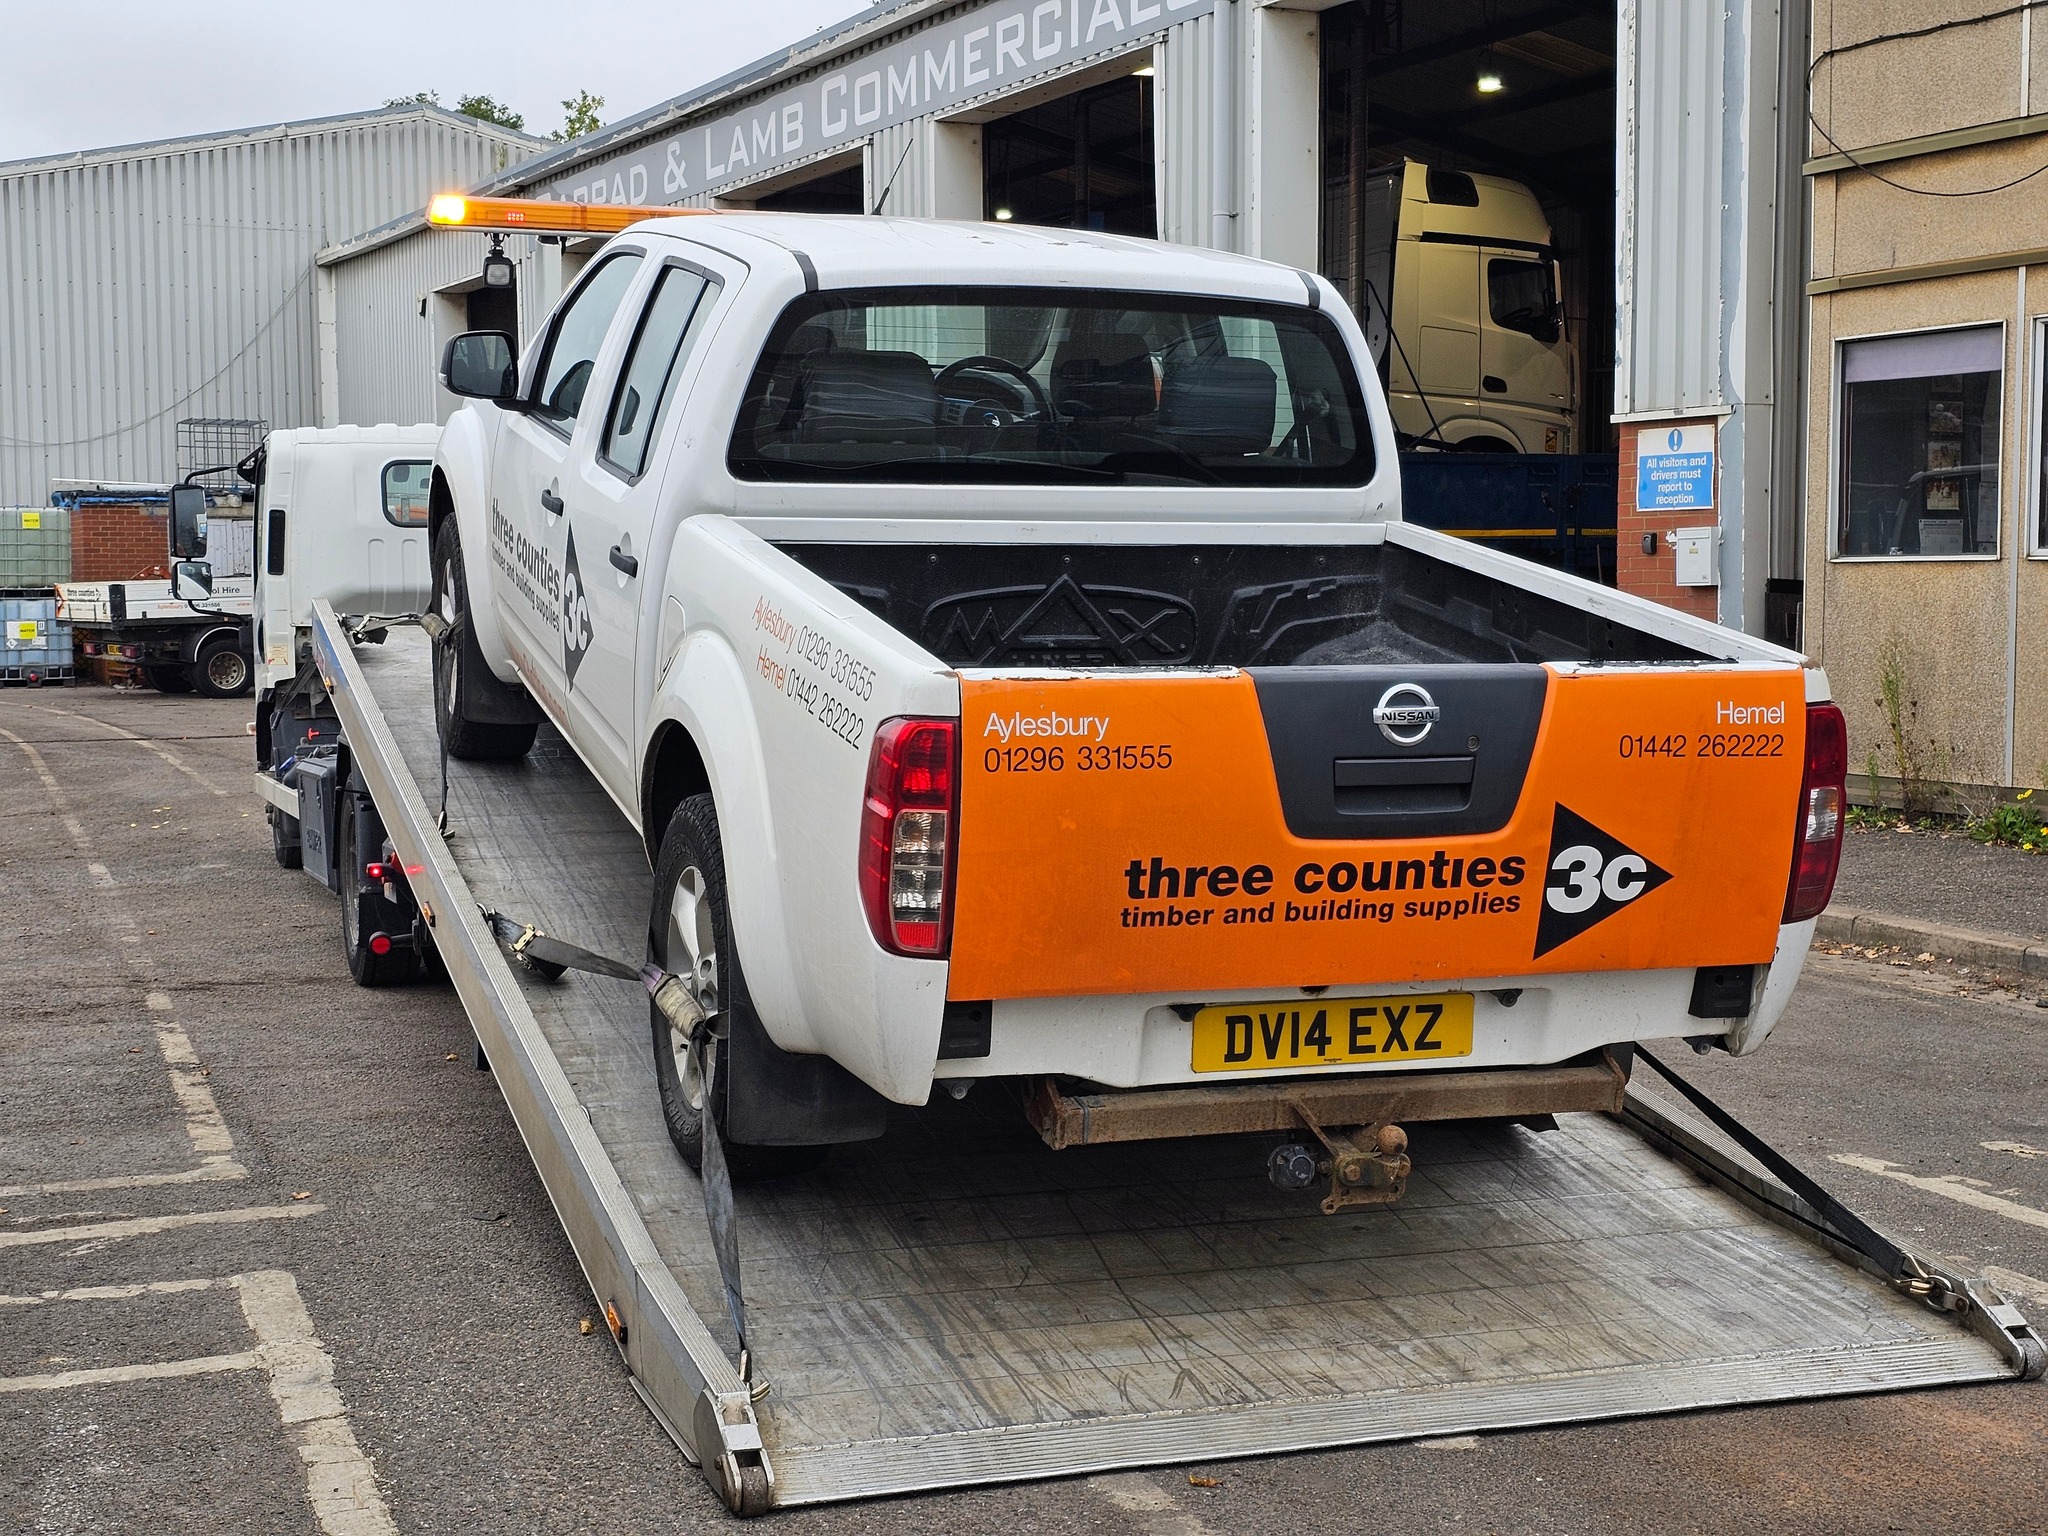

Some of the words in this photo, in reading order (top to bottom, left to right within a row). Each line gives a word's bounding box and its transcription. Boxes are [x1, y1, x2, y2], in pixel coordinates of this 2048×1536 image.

[663, 140, 689, 194] &
[704, 102, 804, 181] LAMB
[820, 0, 1196, 138] COMMERCIAL
[1647, 458, 1656, 468] All
[1659, 458, 1687, 468] visitors
[1690, 456, 1706, 466] and
[1651, 470, 1677, 480] drivers
[1680, 468, 1701, 478] must
[1656, 494, 1693, 506] reception
[1658, 482, 1682, 494] report
[1684, 482, 1692, 490] to
[492, 497, 514, 554] three
[516, 531, 560, 602] counties
[222, 586, 241, 595] Hire
[506, 562, 515, 584] and
[515, 567, 535, 610] building
[536, 594, 560, 633] supplies
[751, 595, 798, 654] Aylesbury
[797, 625, 832, 671] 01296
[830, 648, 877, 702] 331555
[756, 644, 789, 692] Hemel
[786, 668, 819, 715] 01442
[818, 692, 865, 750] 262222
[1716, 700, 1785, 725] Hemel
[983, 711, 1110, 744] Aylesbury
[1381, 710, 1435, 721] NISSAN
[984, 746, 1065, 773] 01296
[1076, 744, 1173, 771] 331555
[1619, 734, 1687, 758] 01442
[1696, 733, 1785, 758] 262222
[1124, 857, 1274, 900] three
[1293, 850, 1526, 894] counties
[1120, 901, 1216, 929] timber
[1222, 900, 1274, 925] and
[1283, 897, 1395, 924] building
[1402, 895, 1521, 921] supplies
[1224, 1009, 1332, 1063] DV14
[1348, 1003, 1444, 1055] EXZ
